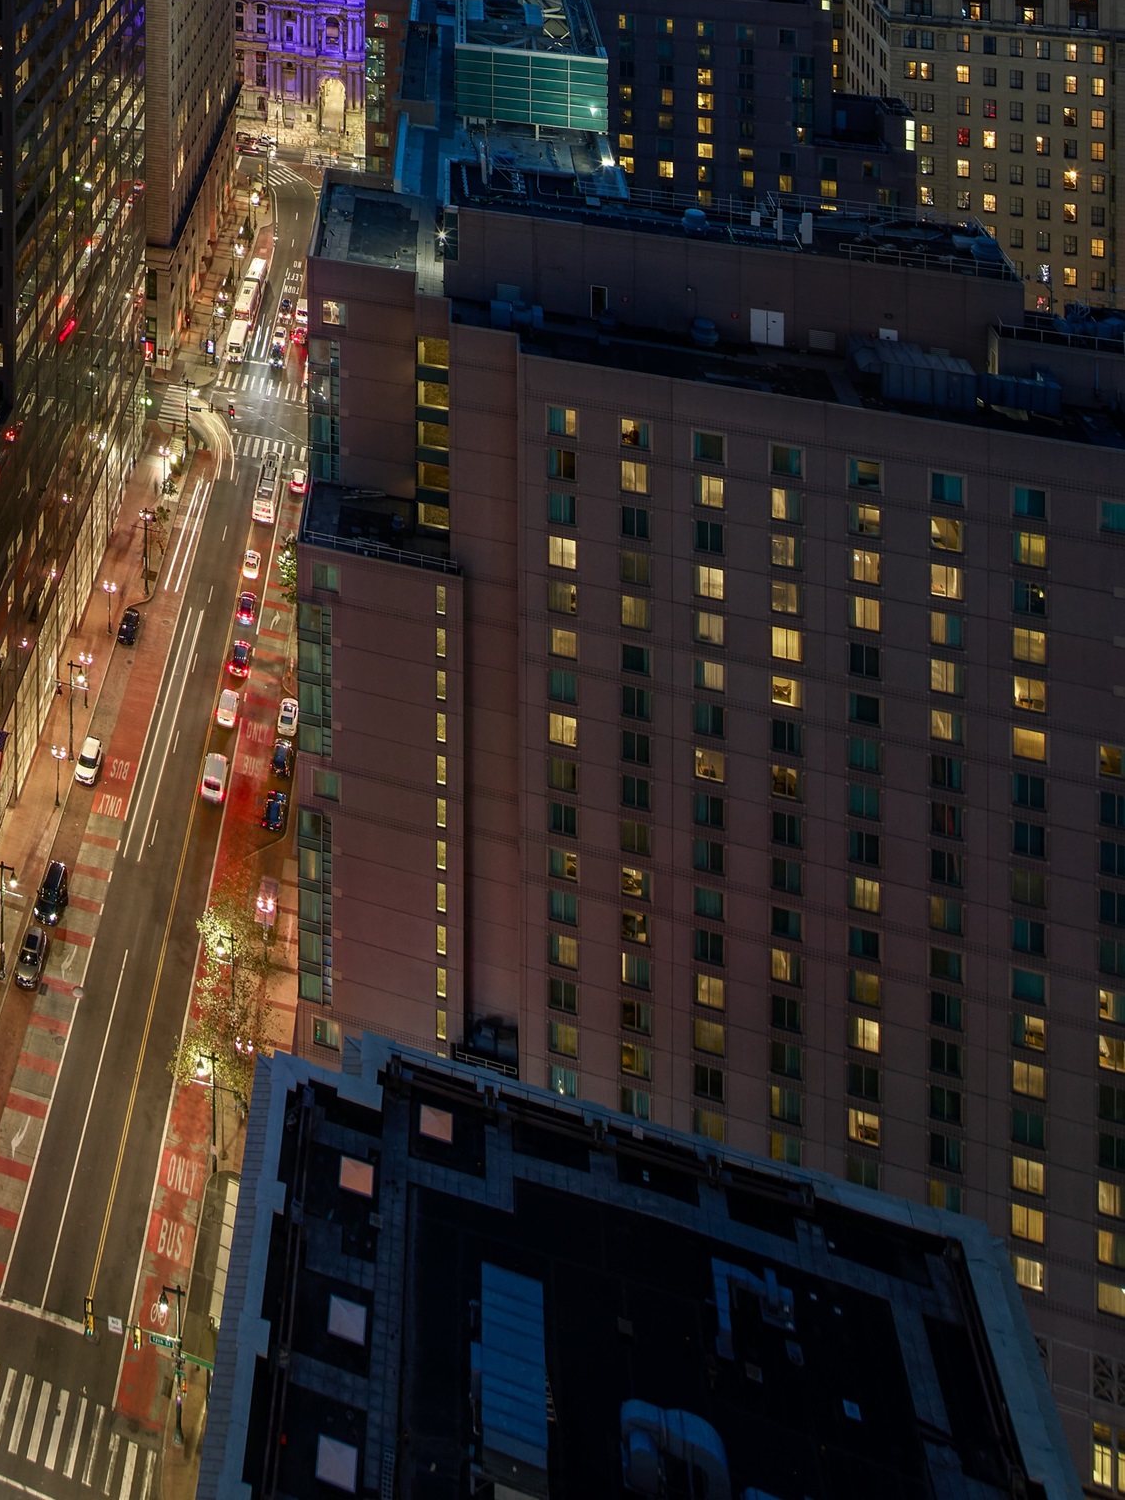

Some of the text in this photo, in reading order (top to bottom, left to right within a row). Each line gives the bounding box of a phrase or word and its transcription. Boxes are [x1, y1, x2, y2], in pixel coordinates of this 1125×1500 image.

[286, 271, 304, 282] LEFT
[283, 284, 300, 295] TURN
[246, 721, 268, 744] ONLY
[109, 758, 131, 781] BUS
[242, 755, 262, 777] BUS
[96, 793, 123, 818] ONLY
[166, 1153, 198, 1197] ONLY
[157, 1217, 185, 1261] BUS
